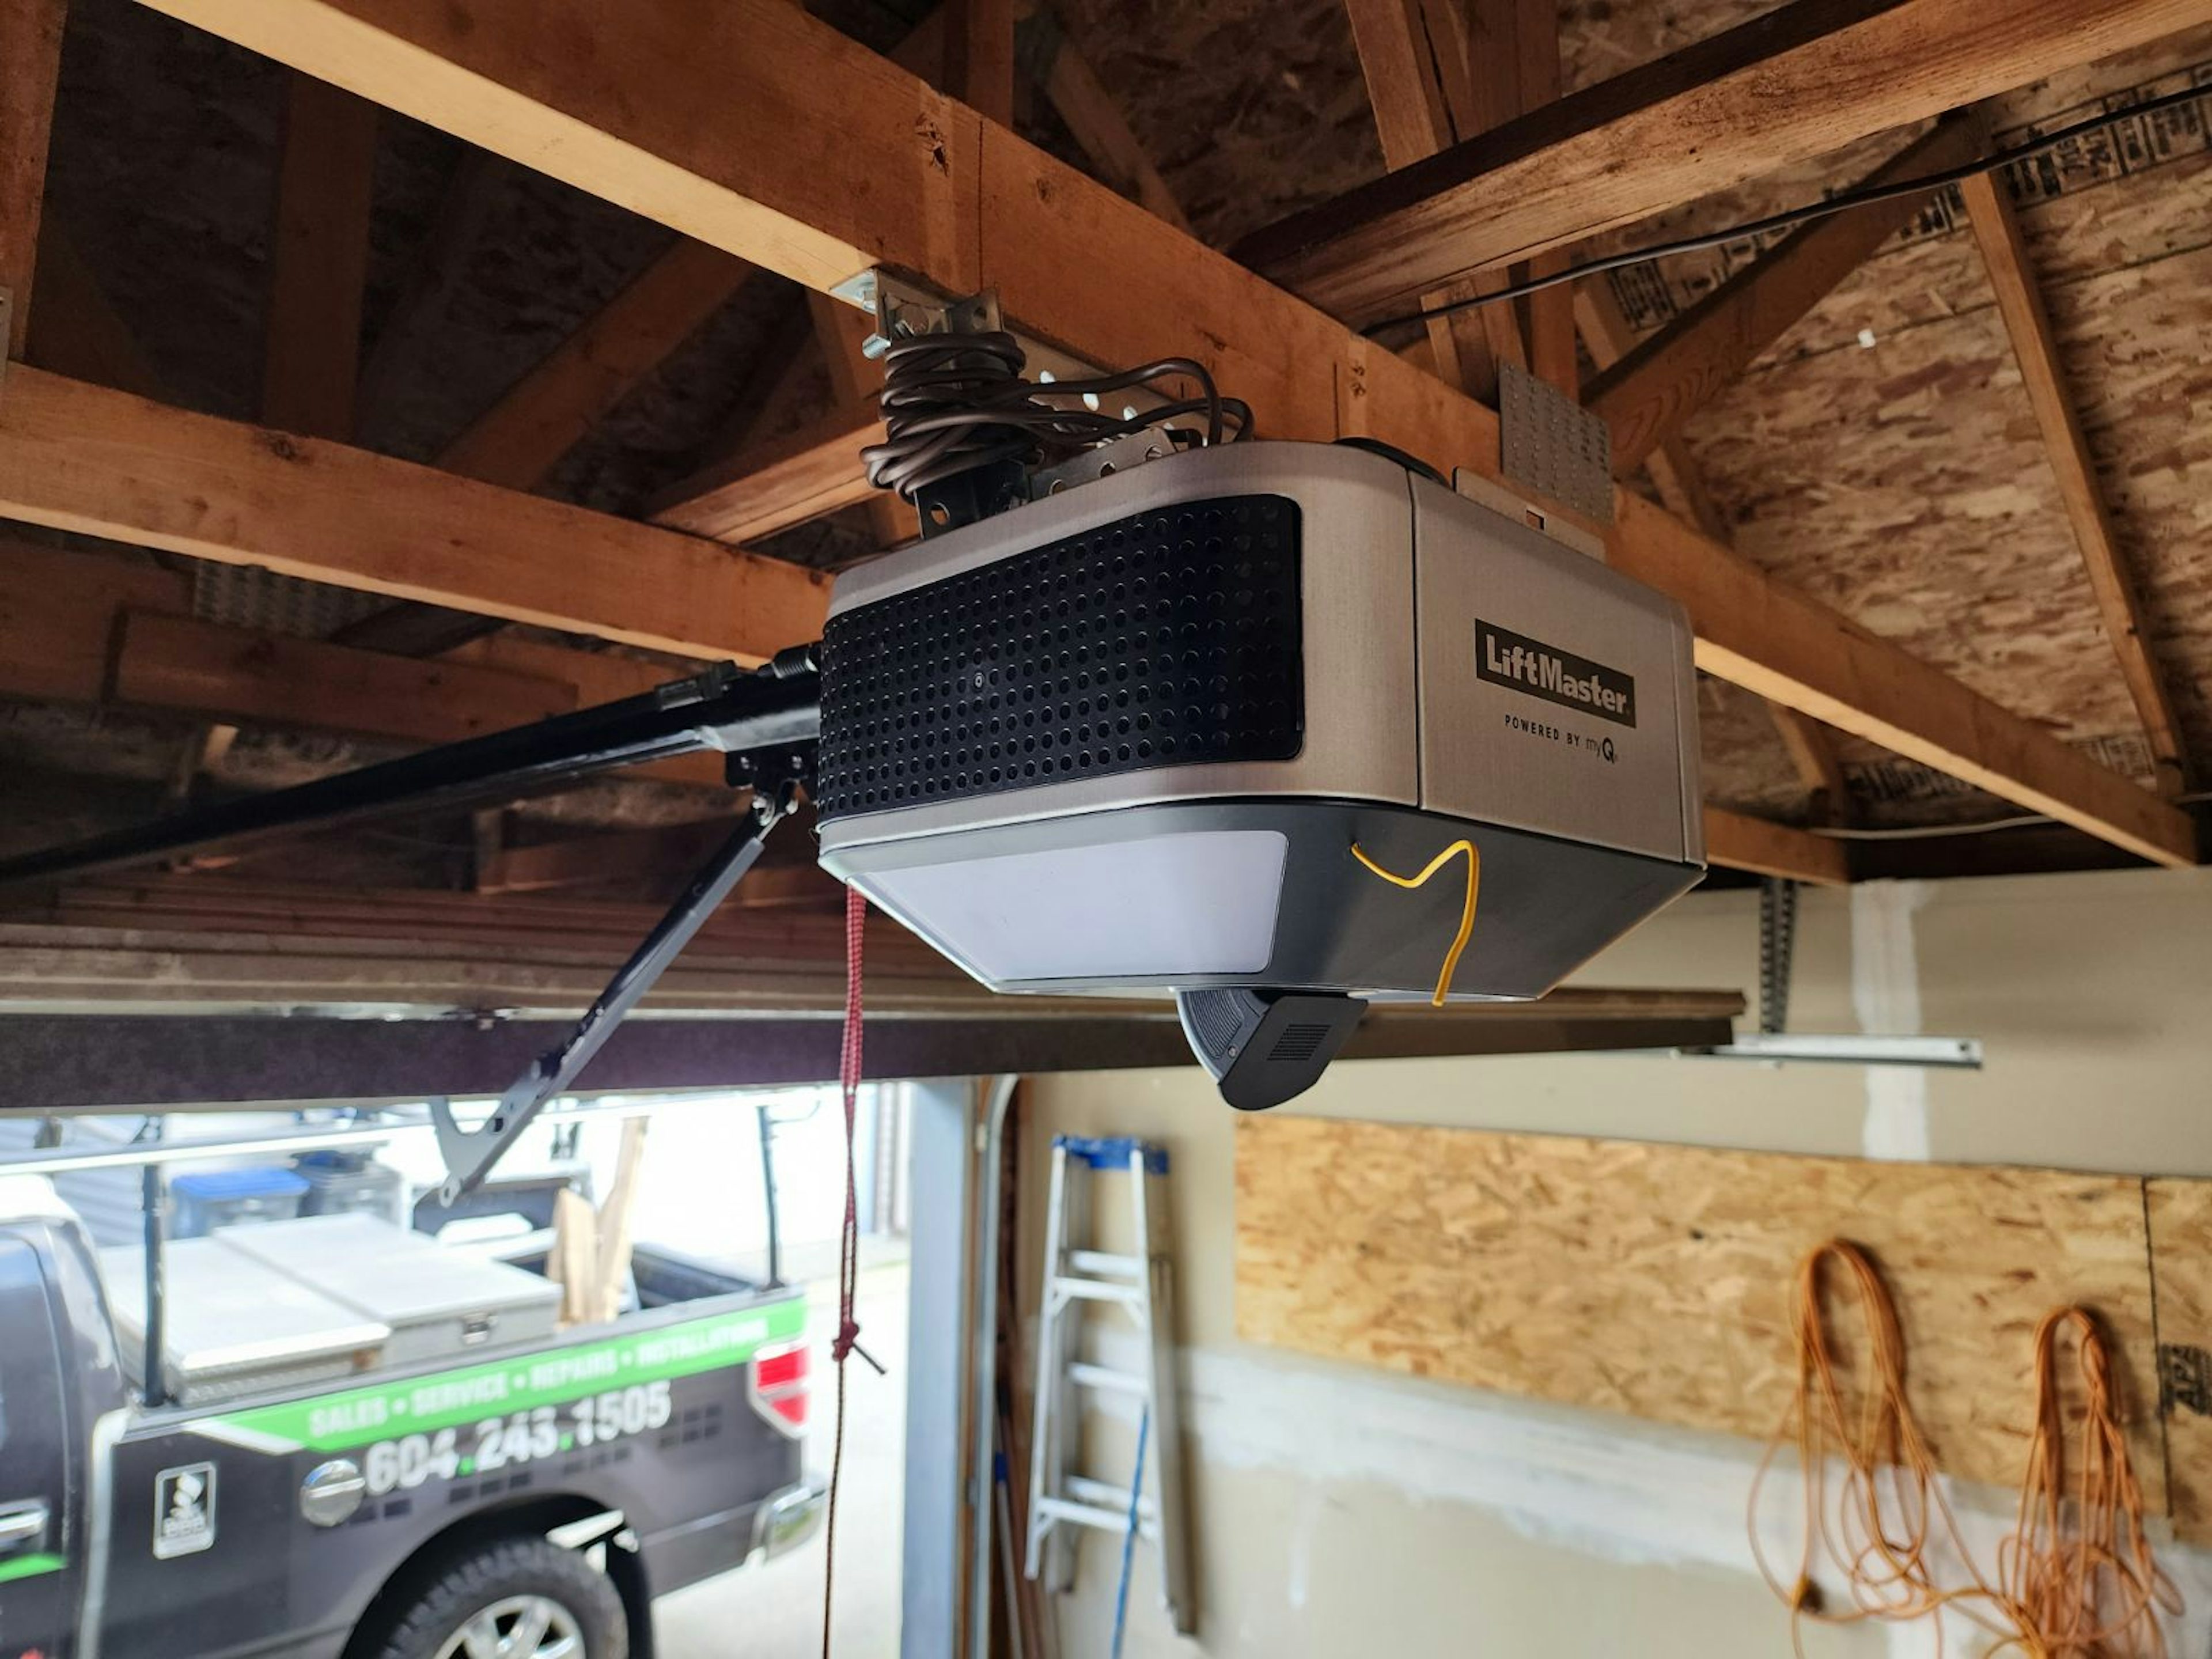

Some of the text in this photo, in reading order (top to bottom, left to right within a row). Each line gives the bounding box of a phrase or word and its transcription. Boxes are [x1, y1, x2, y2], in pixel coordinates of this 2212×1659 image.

[1486, 634, 1627, 714] LiftMaster
[1505, 714, 1615, 764] POWERED BY myQ
[309, 1396, 388, 1438] SALES
[411, 1372, 508, 1416] SERVICE
[531, 1349, 618, 1391] REPAIRS
[366, 1380, 672, 1497] 604.243.1505
